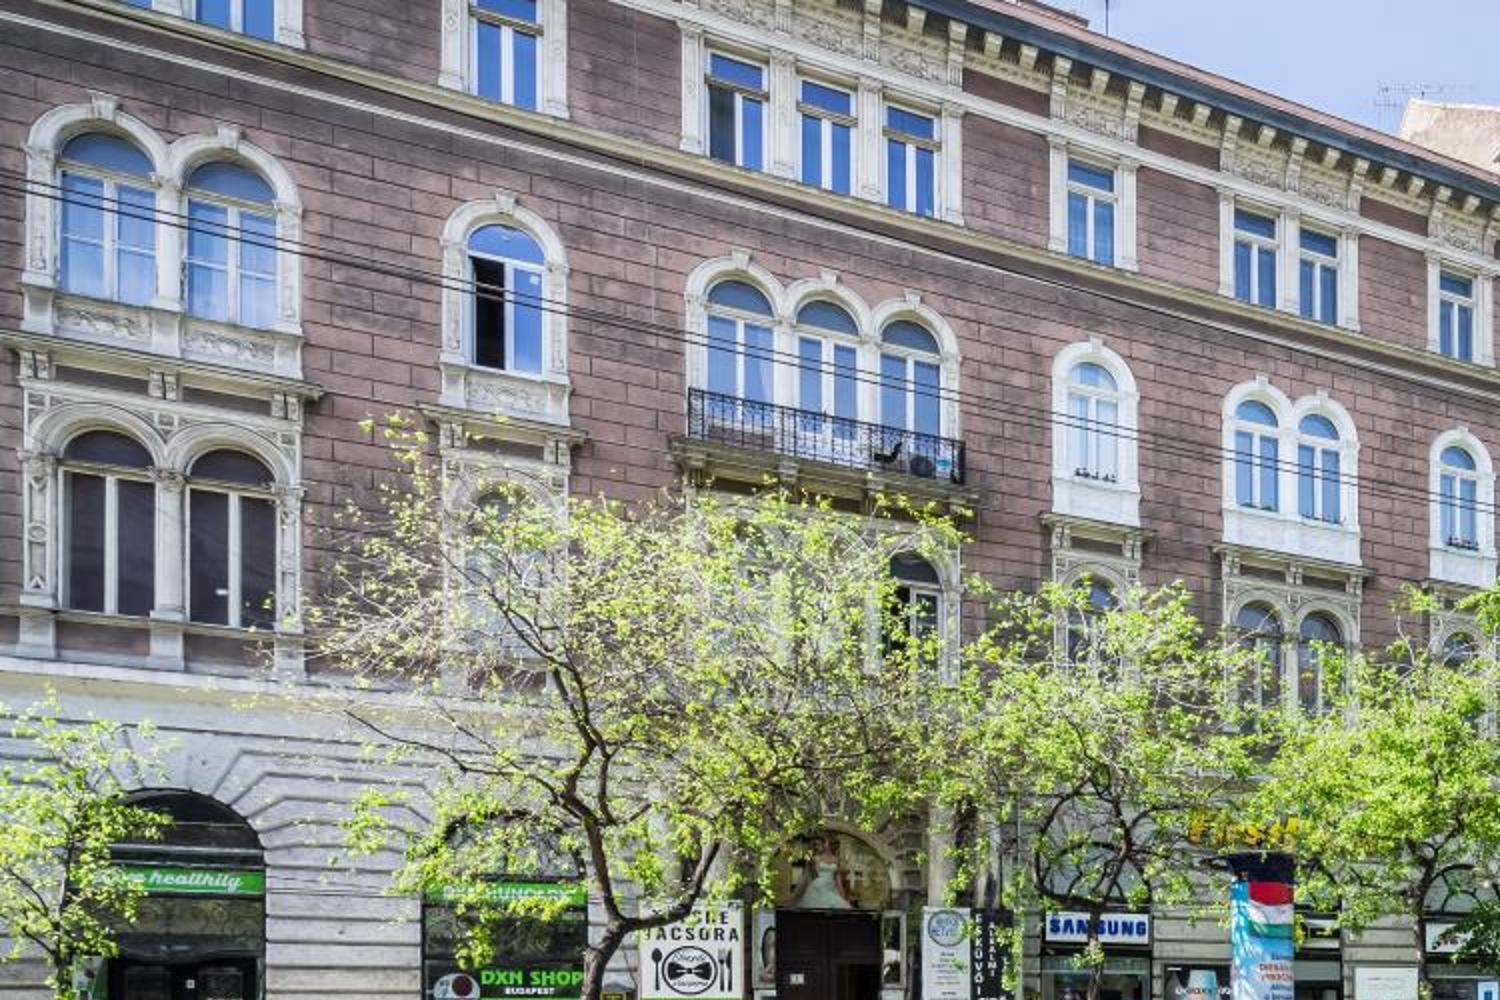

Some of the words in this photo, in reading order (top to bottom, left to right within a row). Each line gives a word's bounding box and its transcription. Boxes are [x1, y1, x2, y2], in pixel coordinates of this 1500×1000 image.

[150, 871, 241, 893] healthily
[1050, 916, 1147, 936] SAMSUNG
[480, 971, 523, 985] DXN
[530, 972, 584, 986] SHOP
